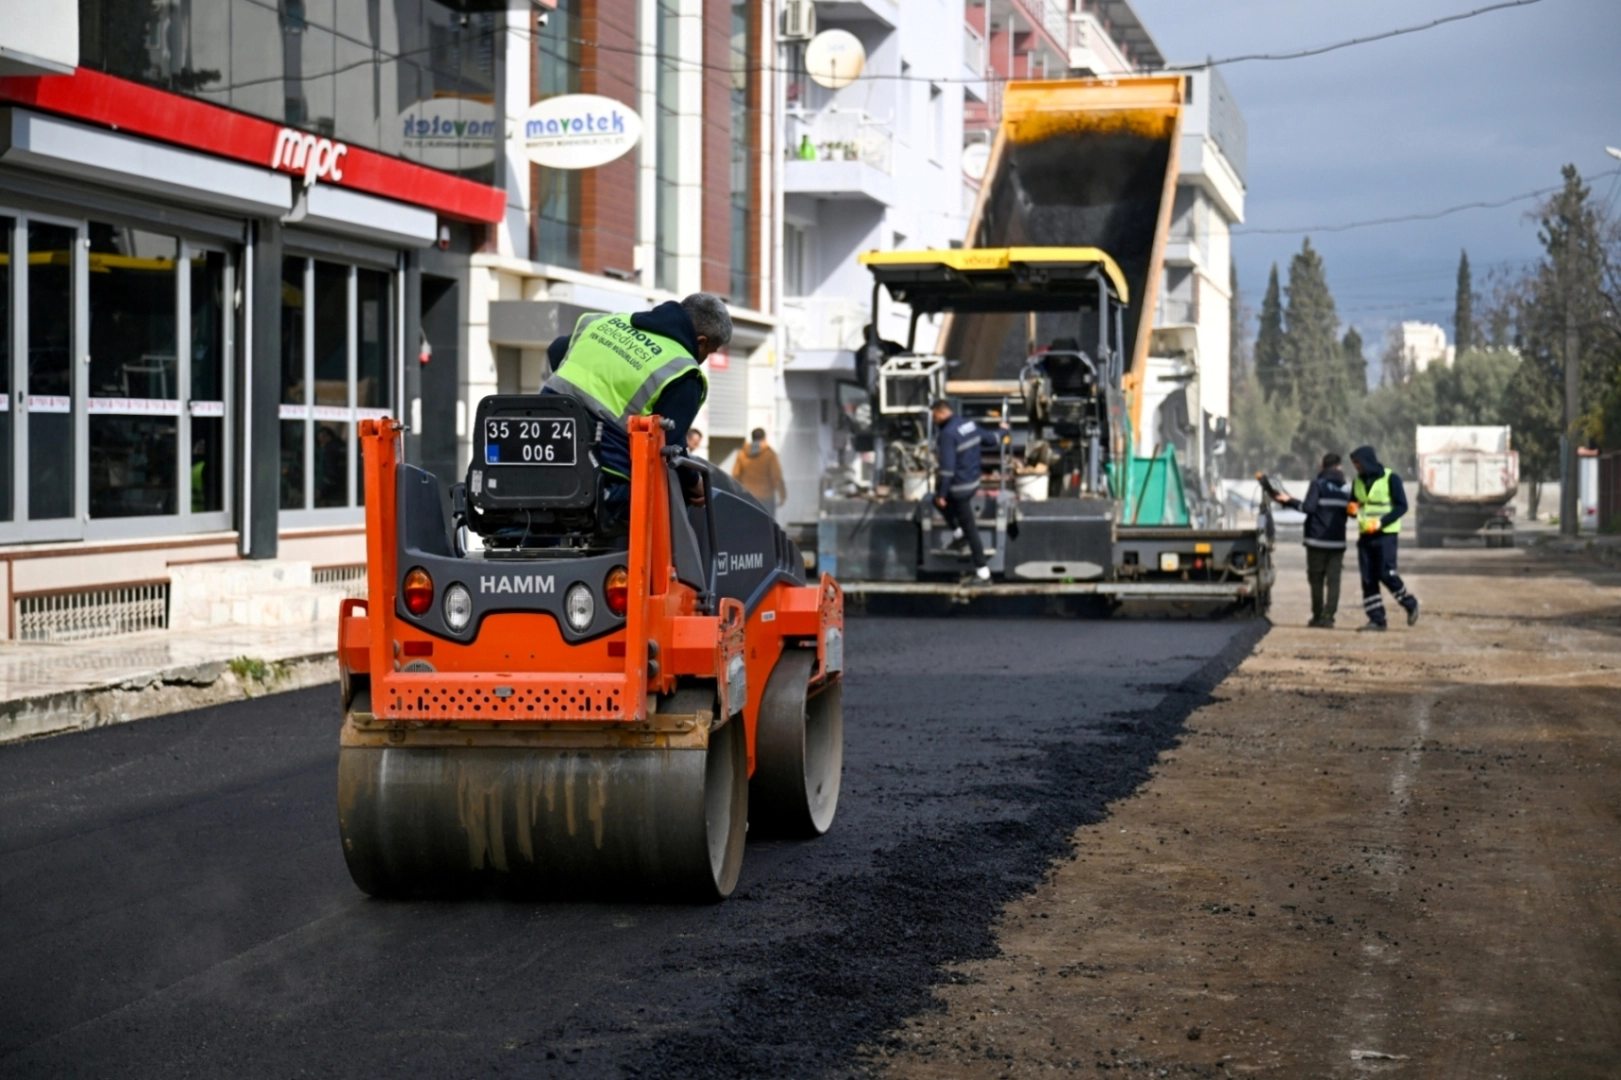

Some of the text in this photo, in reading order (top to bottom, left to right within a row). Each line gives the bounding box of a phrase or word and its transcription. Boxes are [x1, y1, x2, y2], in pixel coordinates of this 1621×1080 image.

[526, 110, 625, 138] mavotek
[597, 323, 655, 362] Belediyesi
[607, 317, 662, 356] Bornova
[488, 422, 572, 439] 35 20 24
[523, 445, 554, 461] 006
[730, 552, 763, 571] HAMM
[480, 575, 555, 593] HAMM
